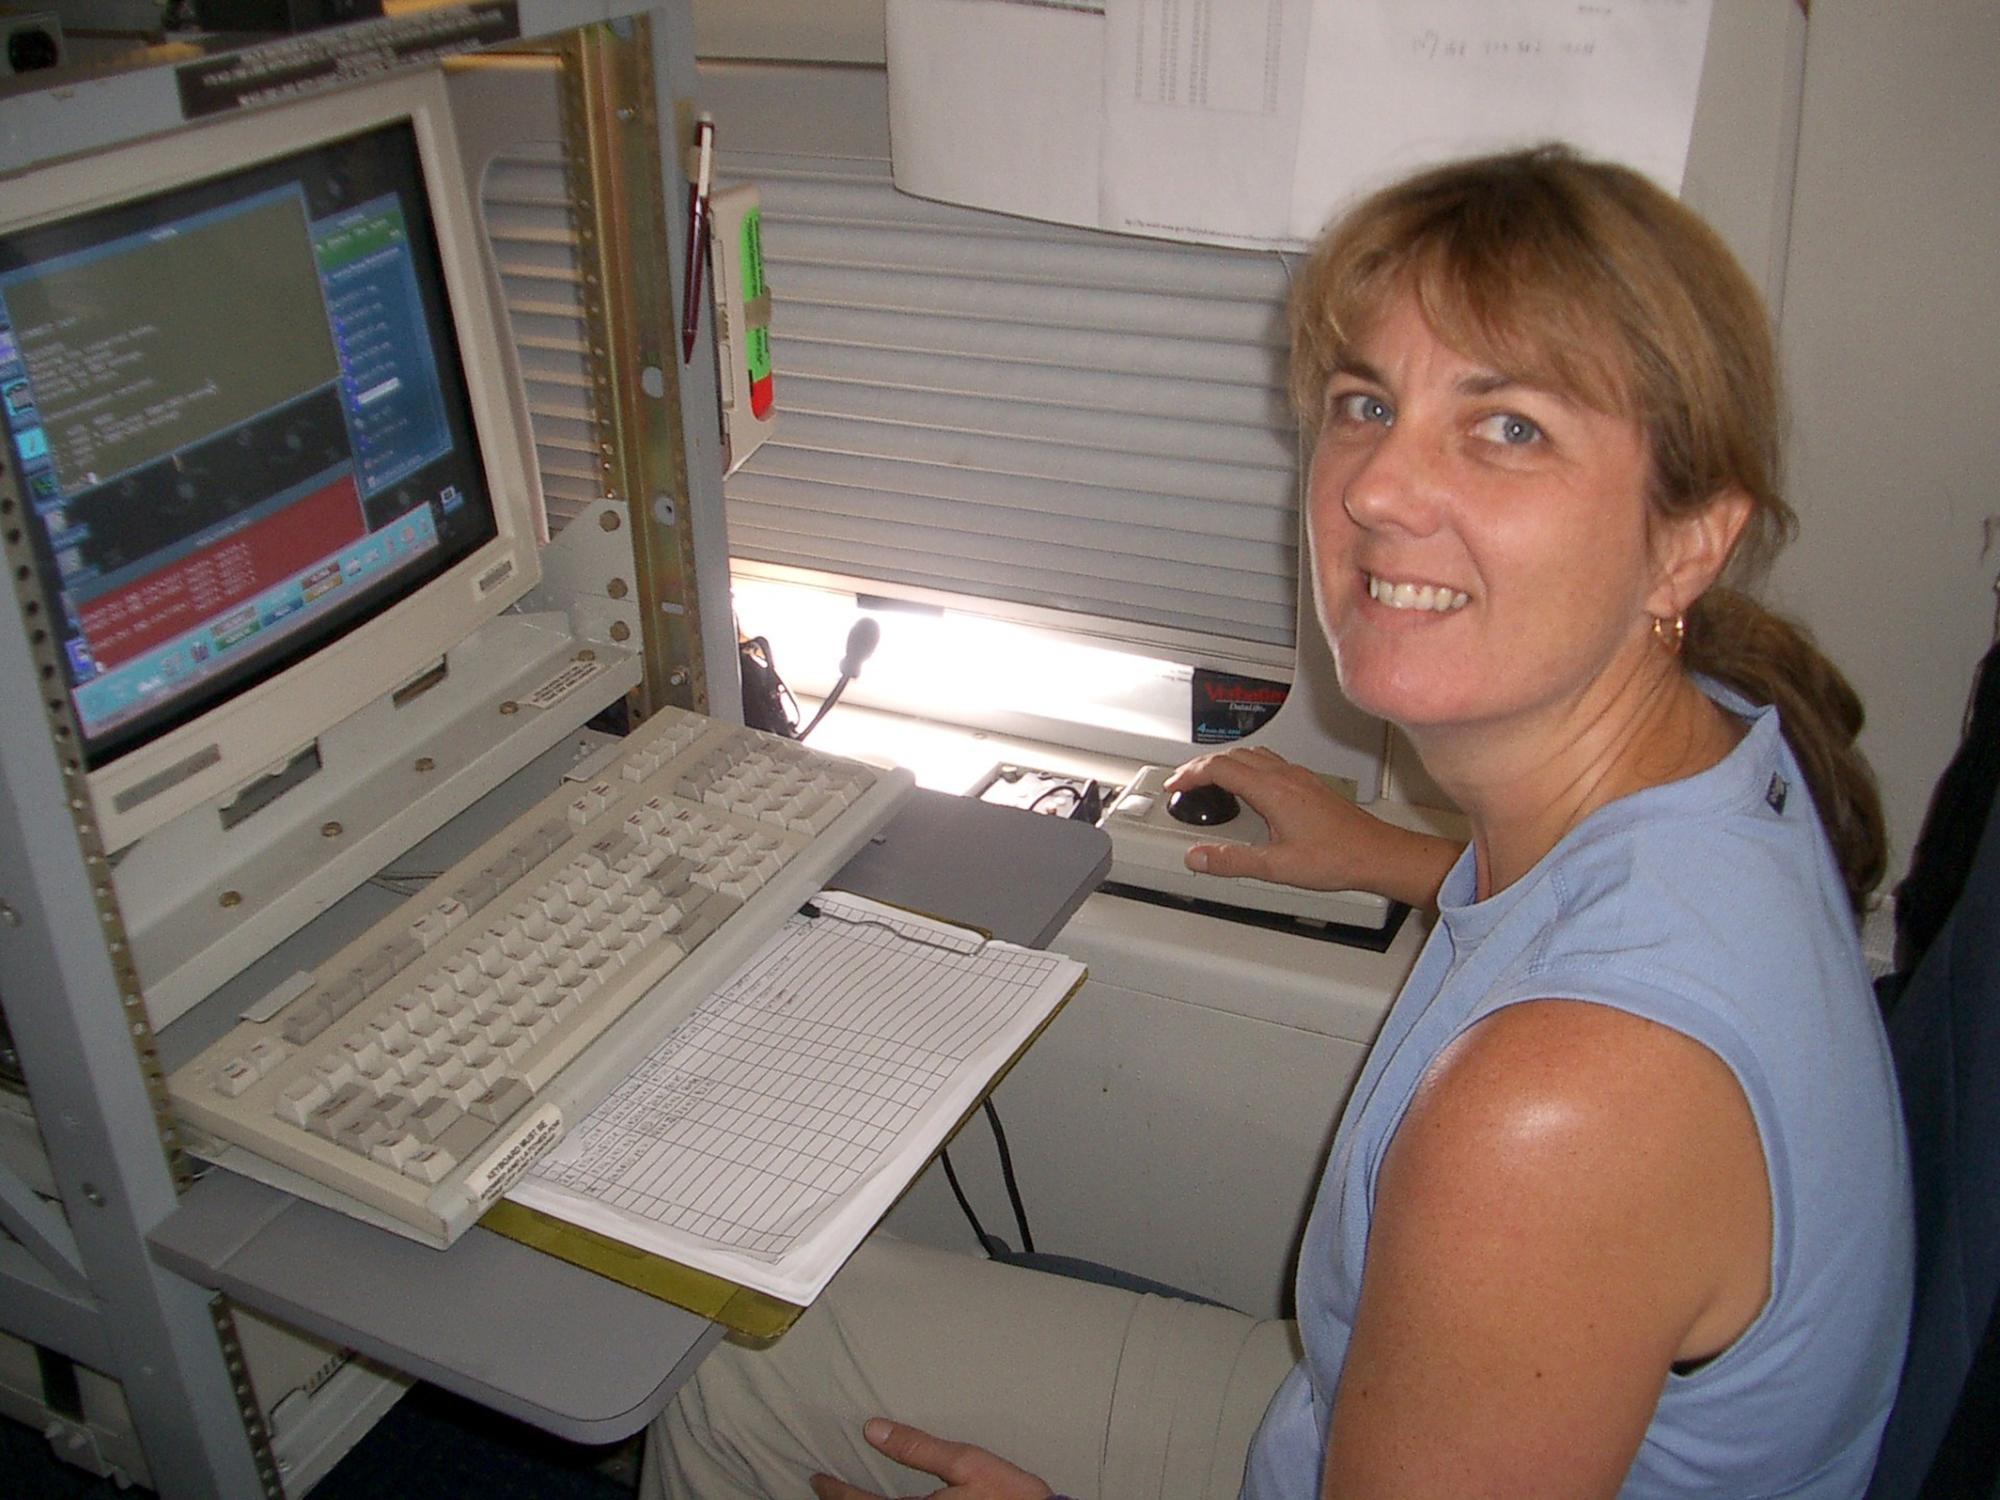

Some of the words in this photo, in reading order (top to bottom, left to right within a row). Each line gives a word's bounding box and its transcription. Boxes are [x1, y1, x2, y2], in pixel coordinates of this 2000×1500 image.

[486, 1145, 521, 1181] KEYBOARD
[520, 1128, 539, 1148] MUST
[536, 1119, 549, 1132] BE
[507, 1158, 521, 1174] AND
